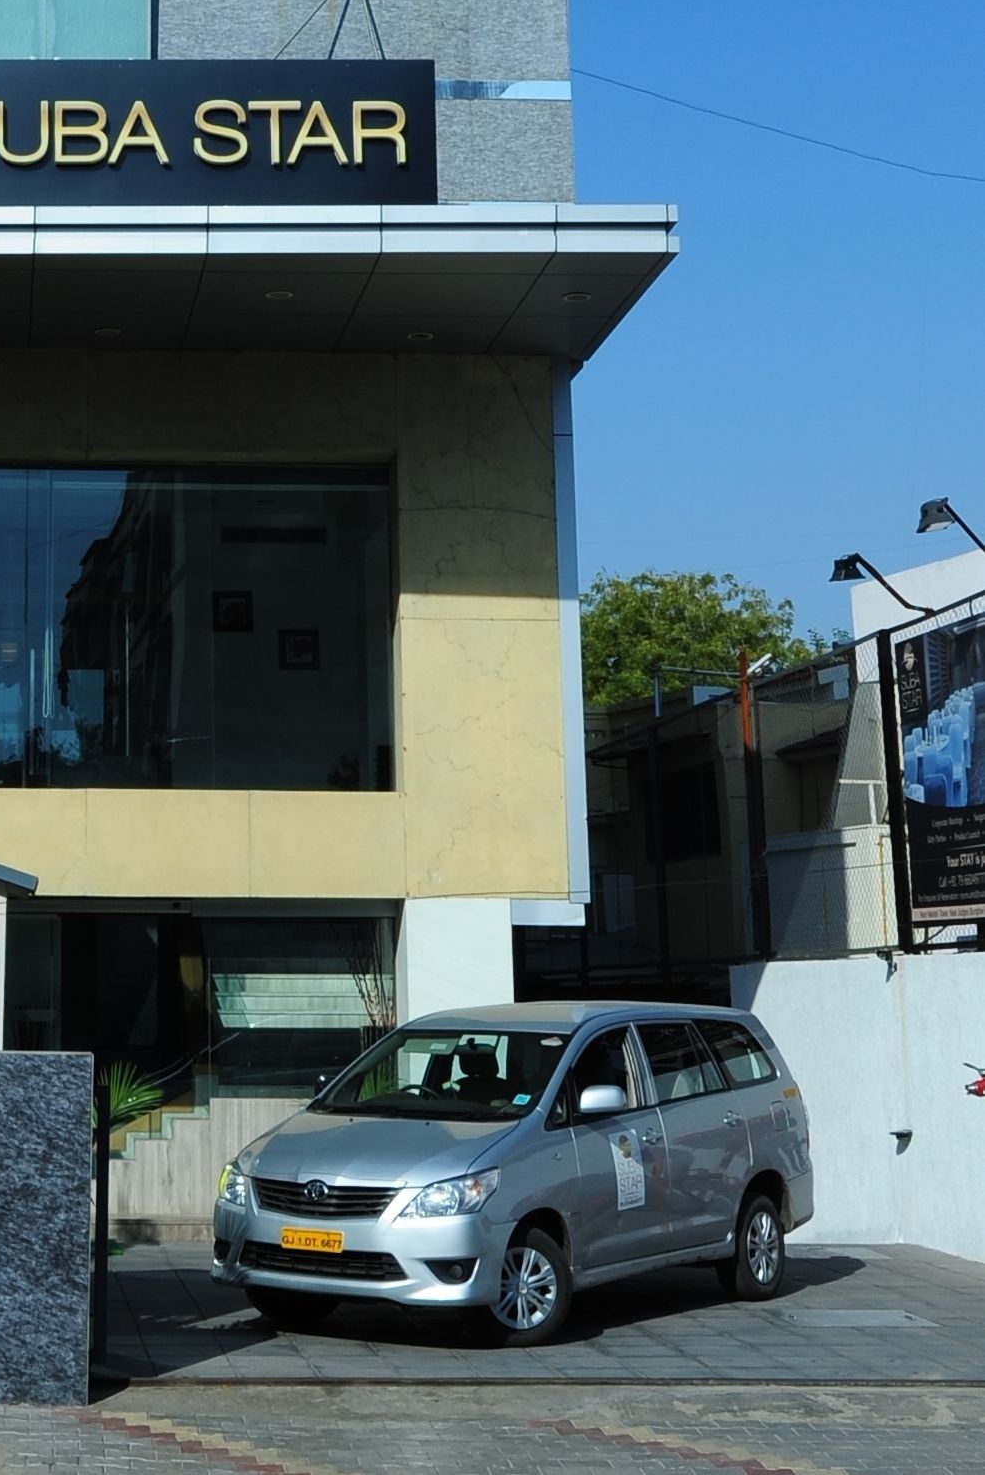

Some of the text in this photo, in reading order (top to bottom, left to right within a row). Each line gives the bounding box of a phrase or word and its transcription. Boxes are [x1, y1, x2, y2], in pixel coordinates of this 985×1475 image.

[193, 99, 407, 165] STAR
[901, 671, 921, 690] SUBA
[902, 688, 923, 710] STAR
[960, 853, 974, 866] STAY
[620, 1174, 644, 1193] STAR
[321, 1238, 342, 1251] 6677
